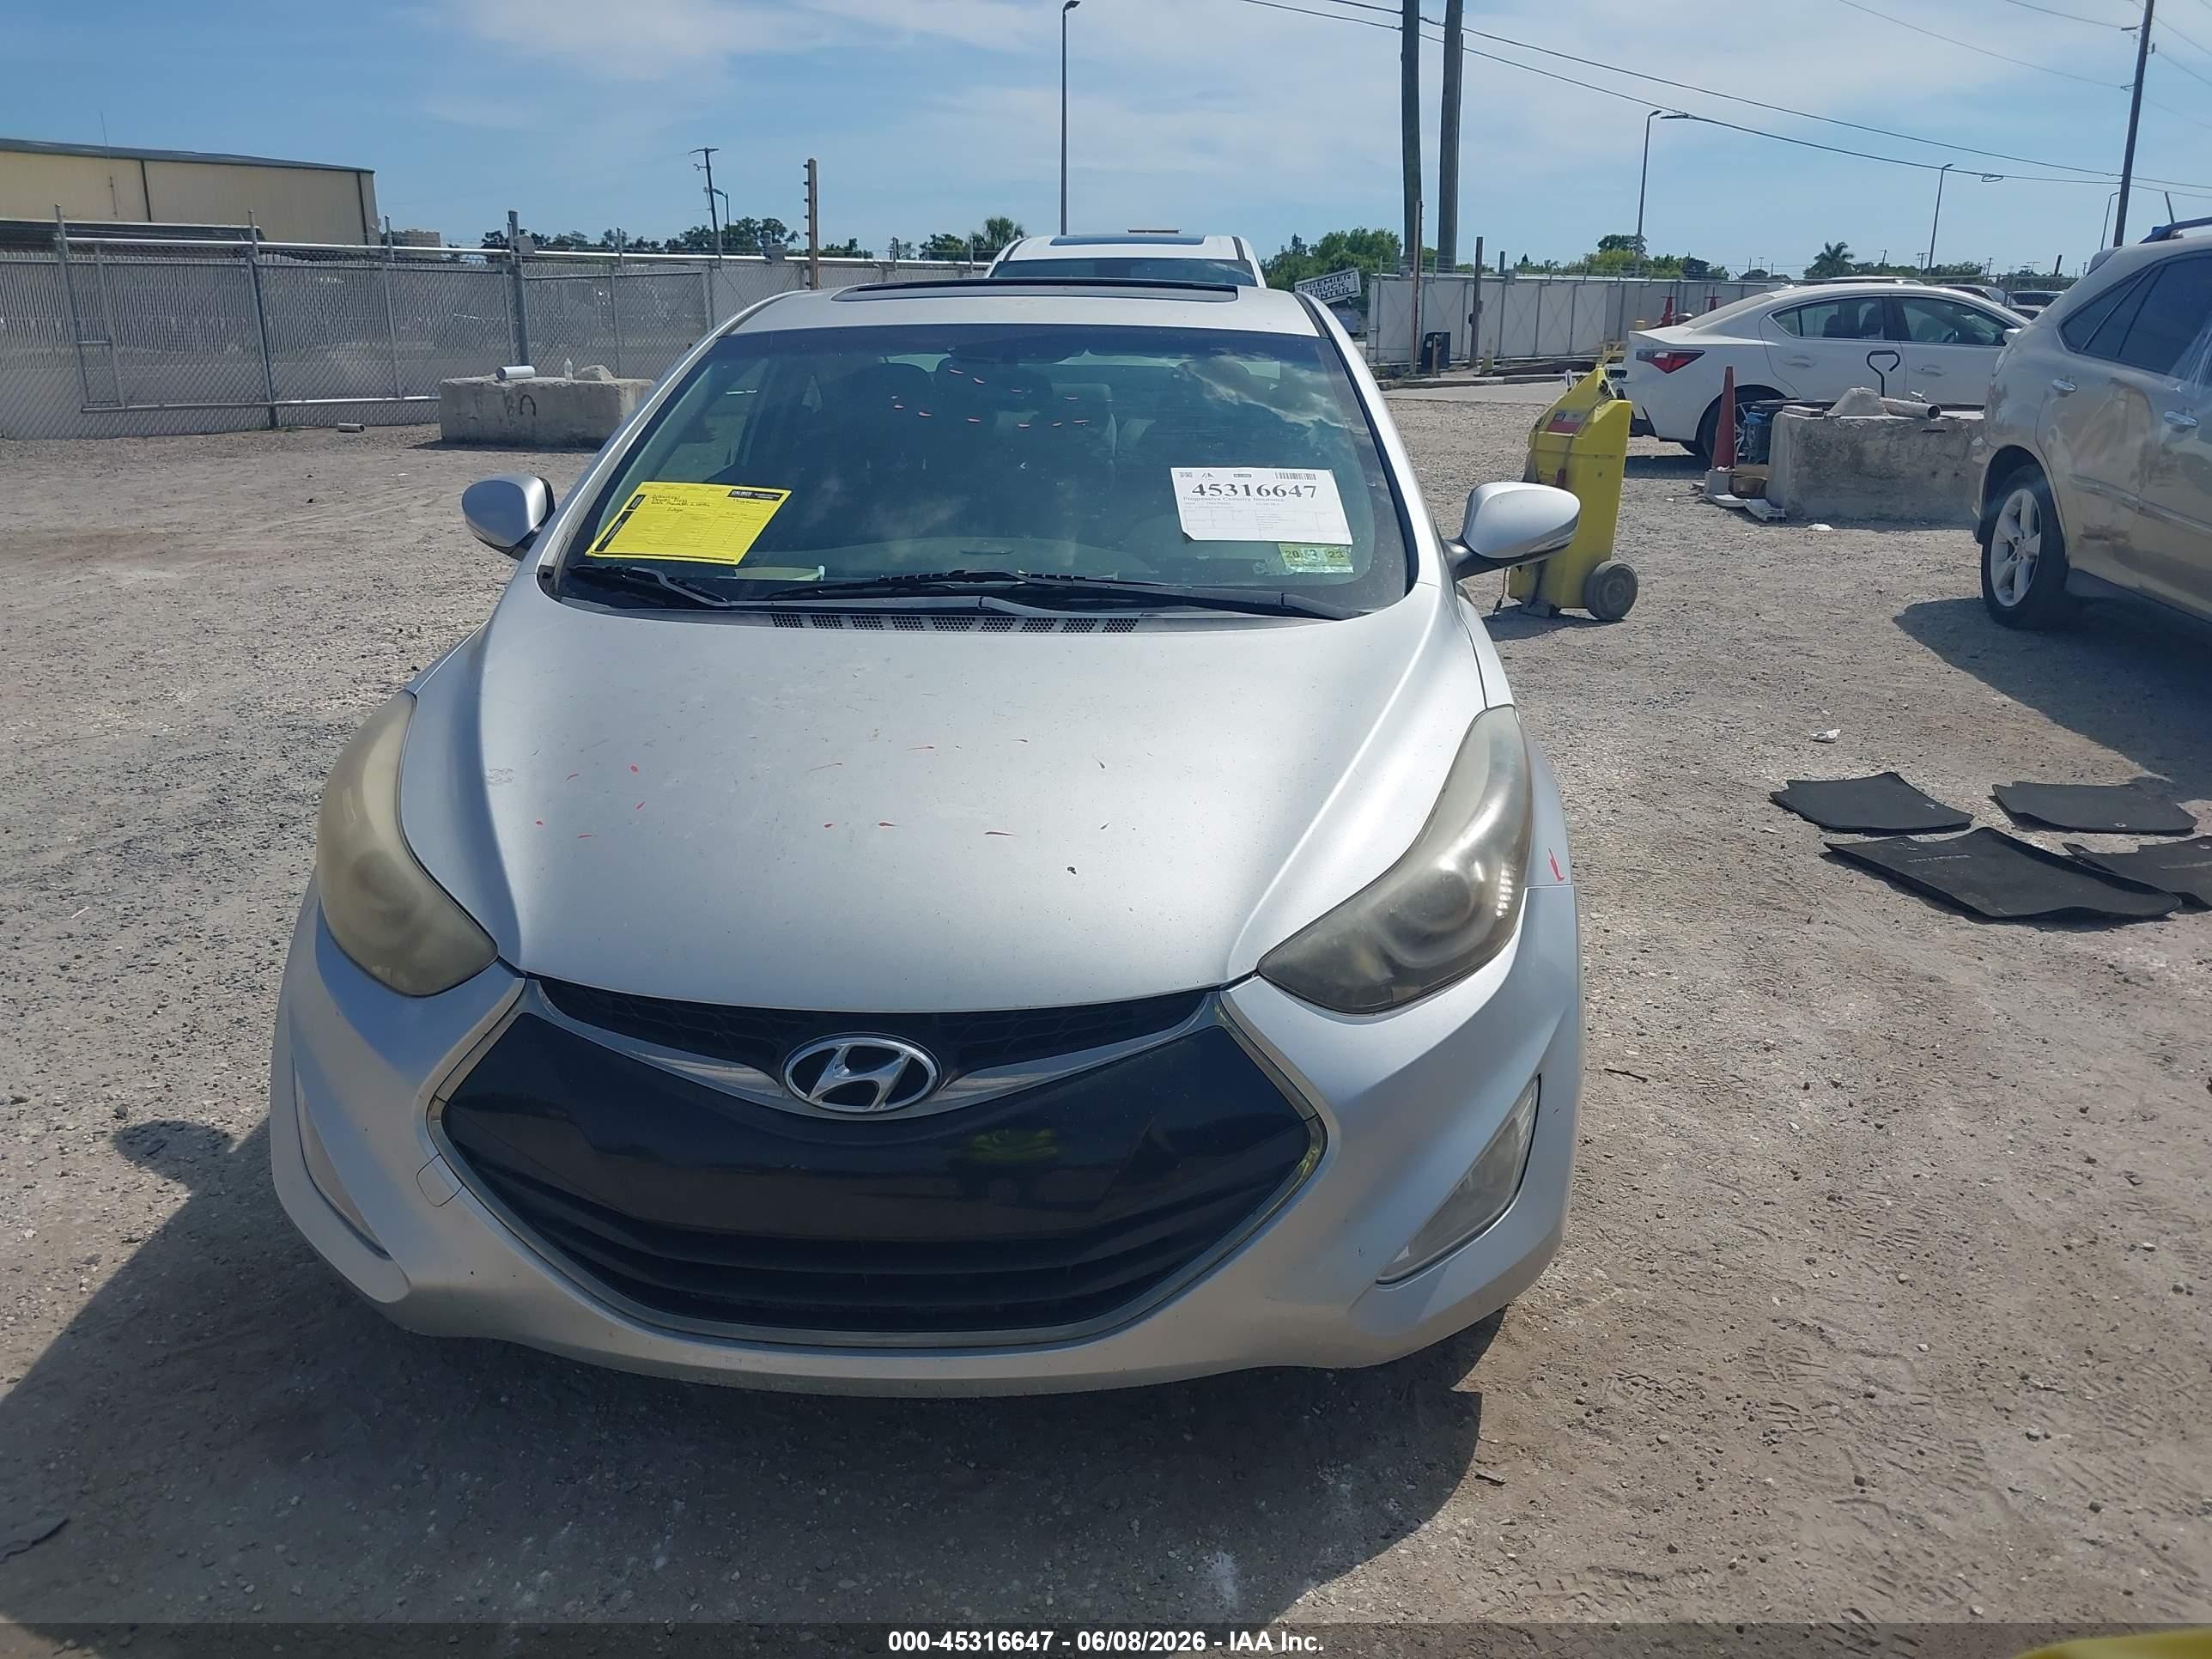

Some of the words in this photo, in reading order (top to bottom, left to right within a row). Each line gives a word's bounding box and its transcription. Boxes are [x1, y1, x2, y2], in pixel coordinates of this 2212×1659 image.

[1301, 274, 1351, 291] PREMIER
[1308, 281, 1346, 295] TRUCK
[1192, 483, 1317, 498] 45316647
[1285, 550, 1300, 558] 20
[1328, 550, 1344, 559] 23
